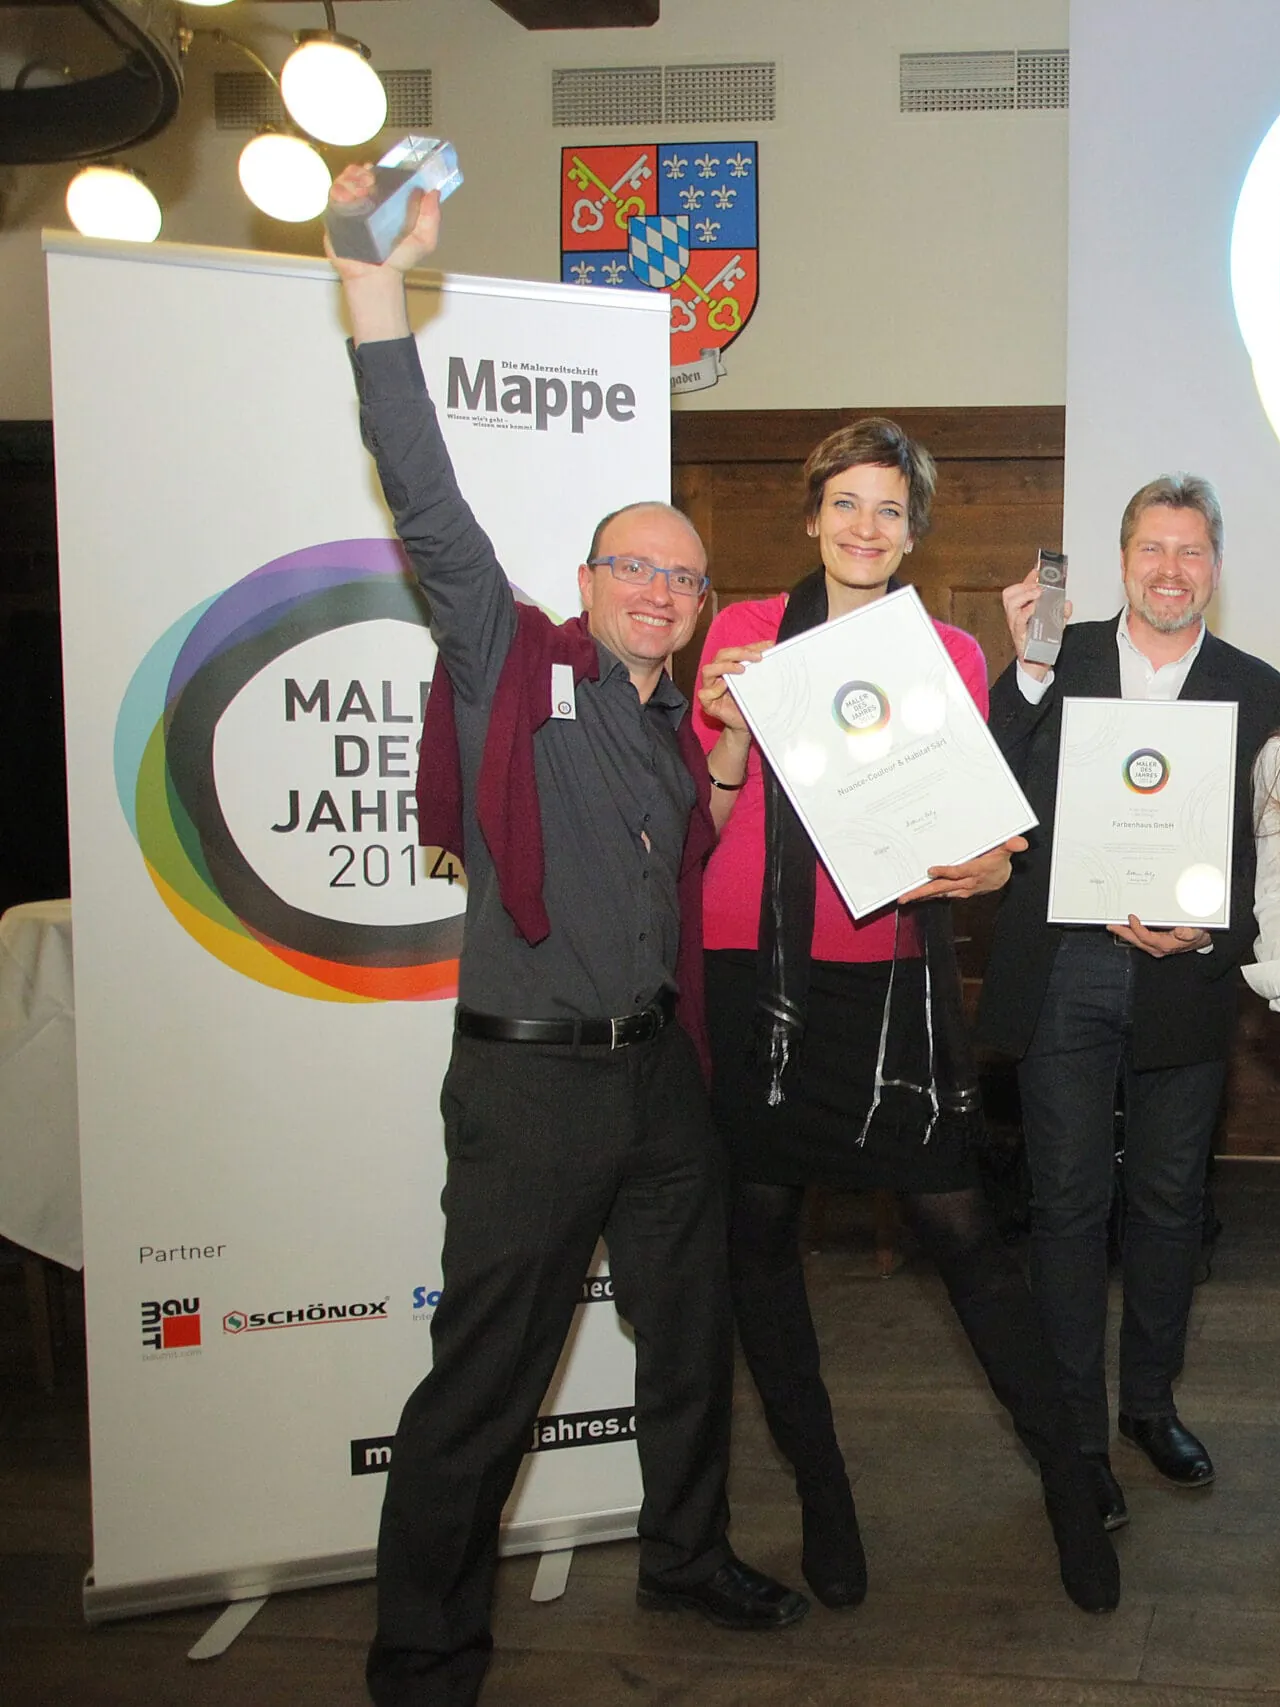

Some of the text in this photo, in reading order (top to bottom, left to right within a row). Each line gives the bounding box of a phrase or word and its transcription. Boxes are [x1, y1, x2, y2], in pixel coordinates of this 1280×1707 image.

[502, 361, 598, 376] Die Malerzeitschrift
[446, 356, 636, 433] Mappe
[334, 734, 421, 778] DE
[1112, 820, 1152, 829] Farbenhaus
[329, 844, 459, 888] 2014
[140, 1245, 226, 1264] Partner
[249, 1301, 387, 1327] SCHÖNOX
